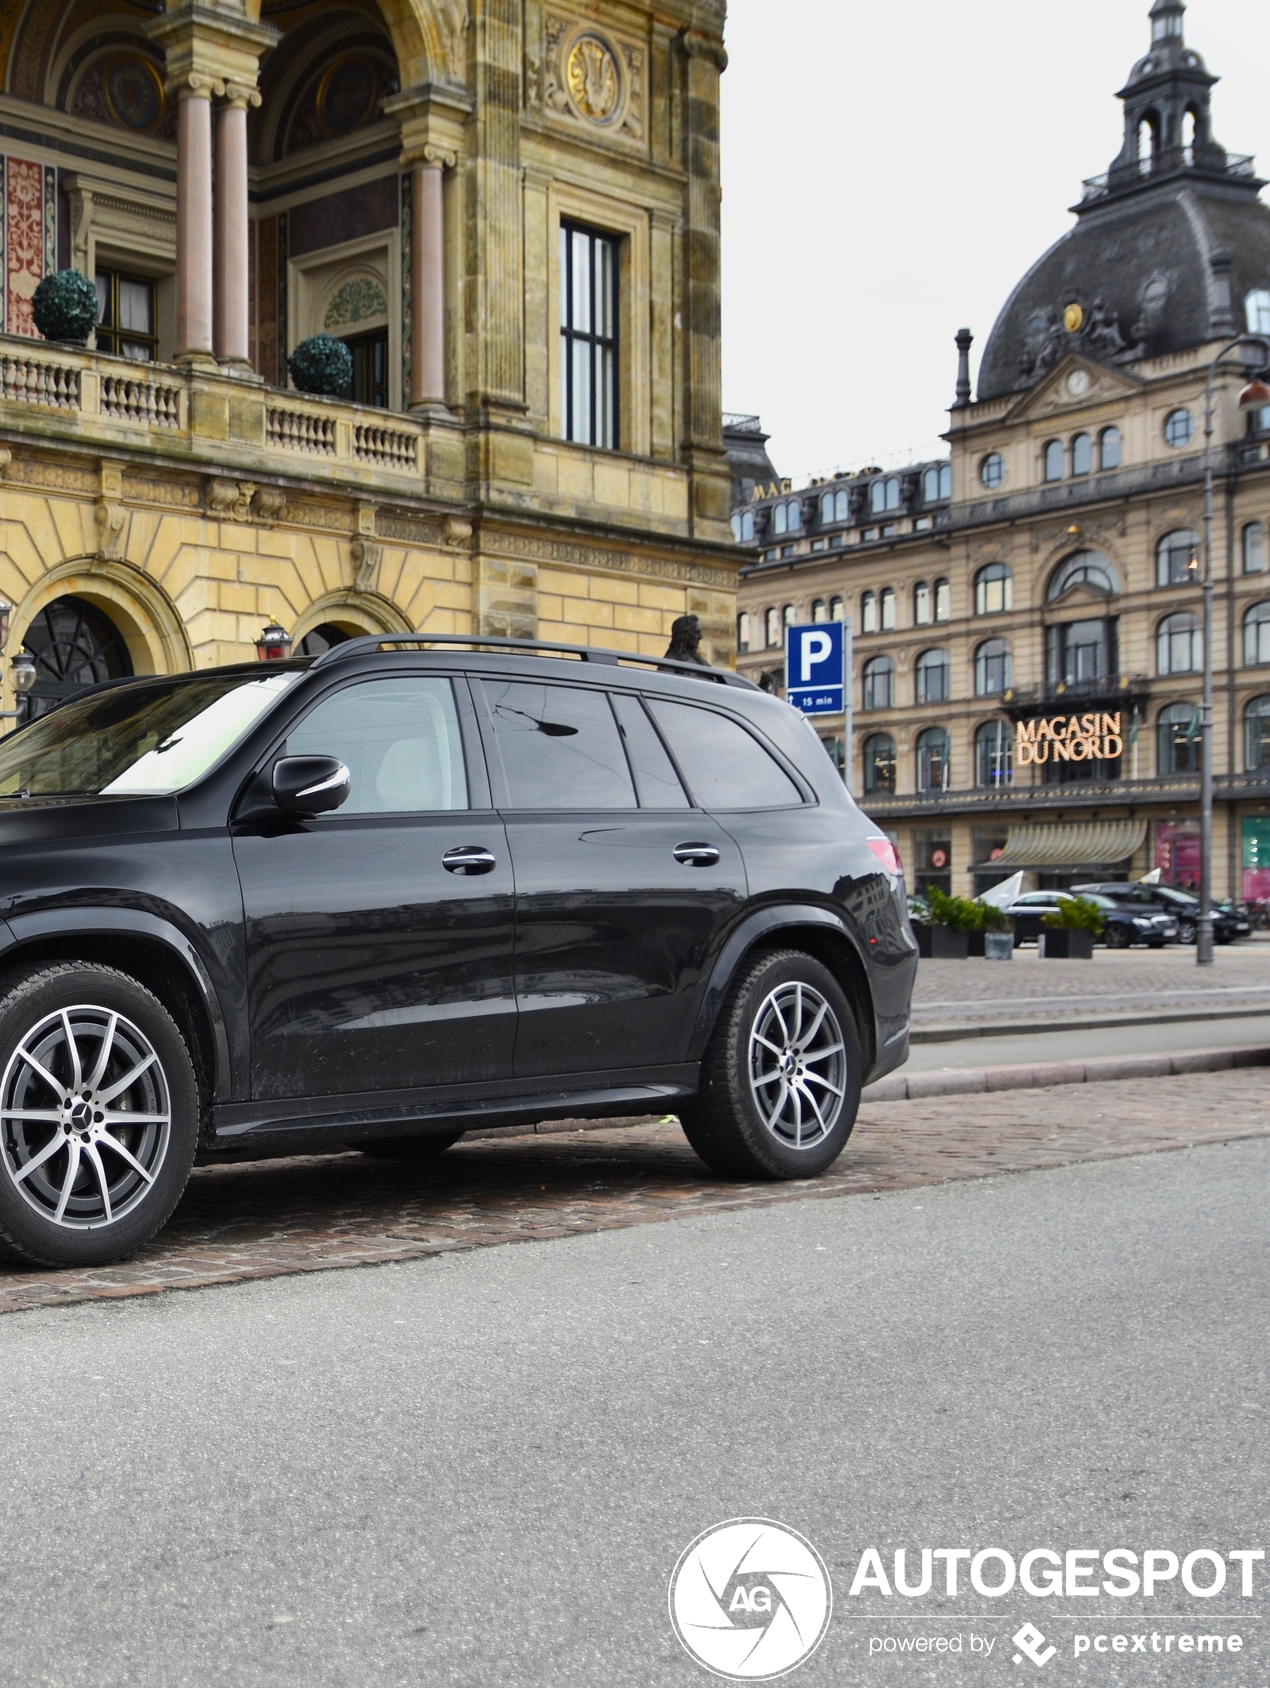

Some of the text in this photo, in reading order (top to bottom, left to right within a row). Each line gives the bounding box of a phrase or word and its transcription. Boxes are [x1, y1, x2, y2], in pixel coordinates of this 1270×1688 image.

[801, 630, 832, 681] P
[802, 696, 833, 707] 15 min
[1016, 711, 1121, 743] MAGASIN
[1017, 734, 1123, 765] DU NORD
